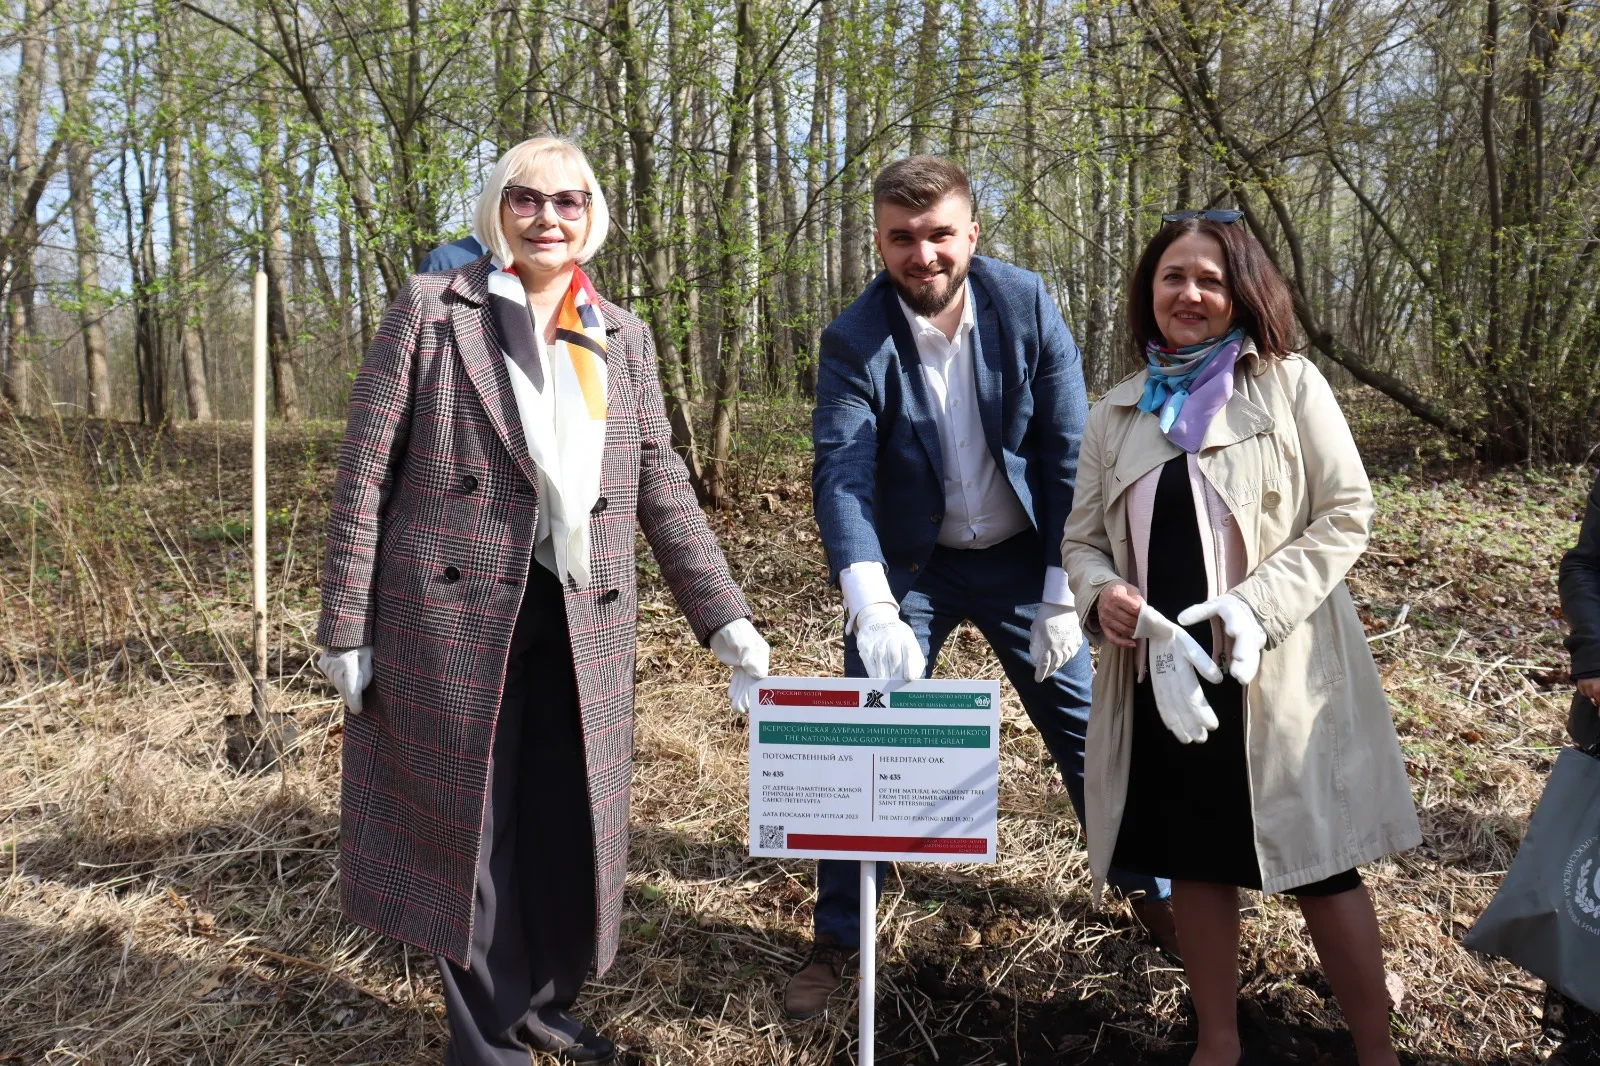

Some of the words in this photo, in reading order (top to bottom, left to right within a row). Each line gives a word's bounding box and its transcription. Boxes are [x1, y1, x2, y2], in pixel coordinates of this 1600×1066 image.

[762, 724, 829, 734] ВСЕРОССИЙСКАЯ
[830, 726, 865, 734] ДУБРАВА
[866, 728, 919, 736] ИМПЕРАТОРА
[921, 728, 945, 736] ПЕТРА
[947, 729, 988, 737] ВЕЛИКОГО
[784, 734, 801, 742] THE
[801, 735, 840, 743] NATIONAL
[841, 736, 858, 744] OAK
[859, 736, 886, 744] GROVE
[887, 737, 899, 745] OF
[900, 737, 922, 745] PETER
[923, 737, 939, 745] THE
[940, 738, 965, 746] GREAT
[762, 752, 836, 761] ПОТОМСТВЕННЫЙ
[879, 756, 927, 764] HEREDITARY
[928, 756, 945, 764] OAK
[772, 770, 784, 778] 435
